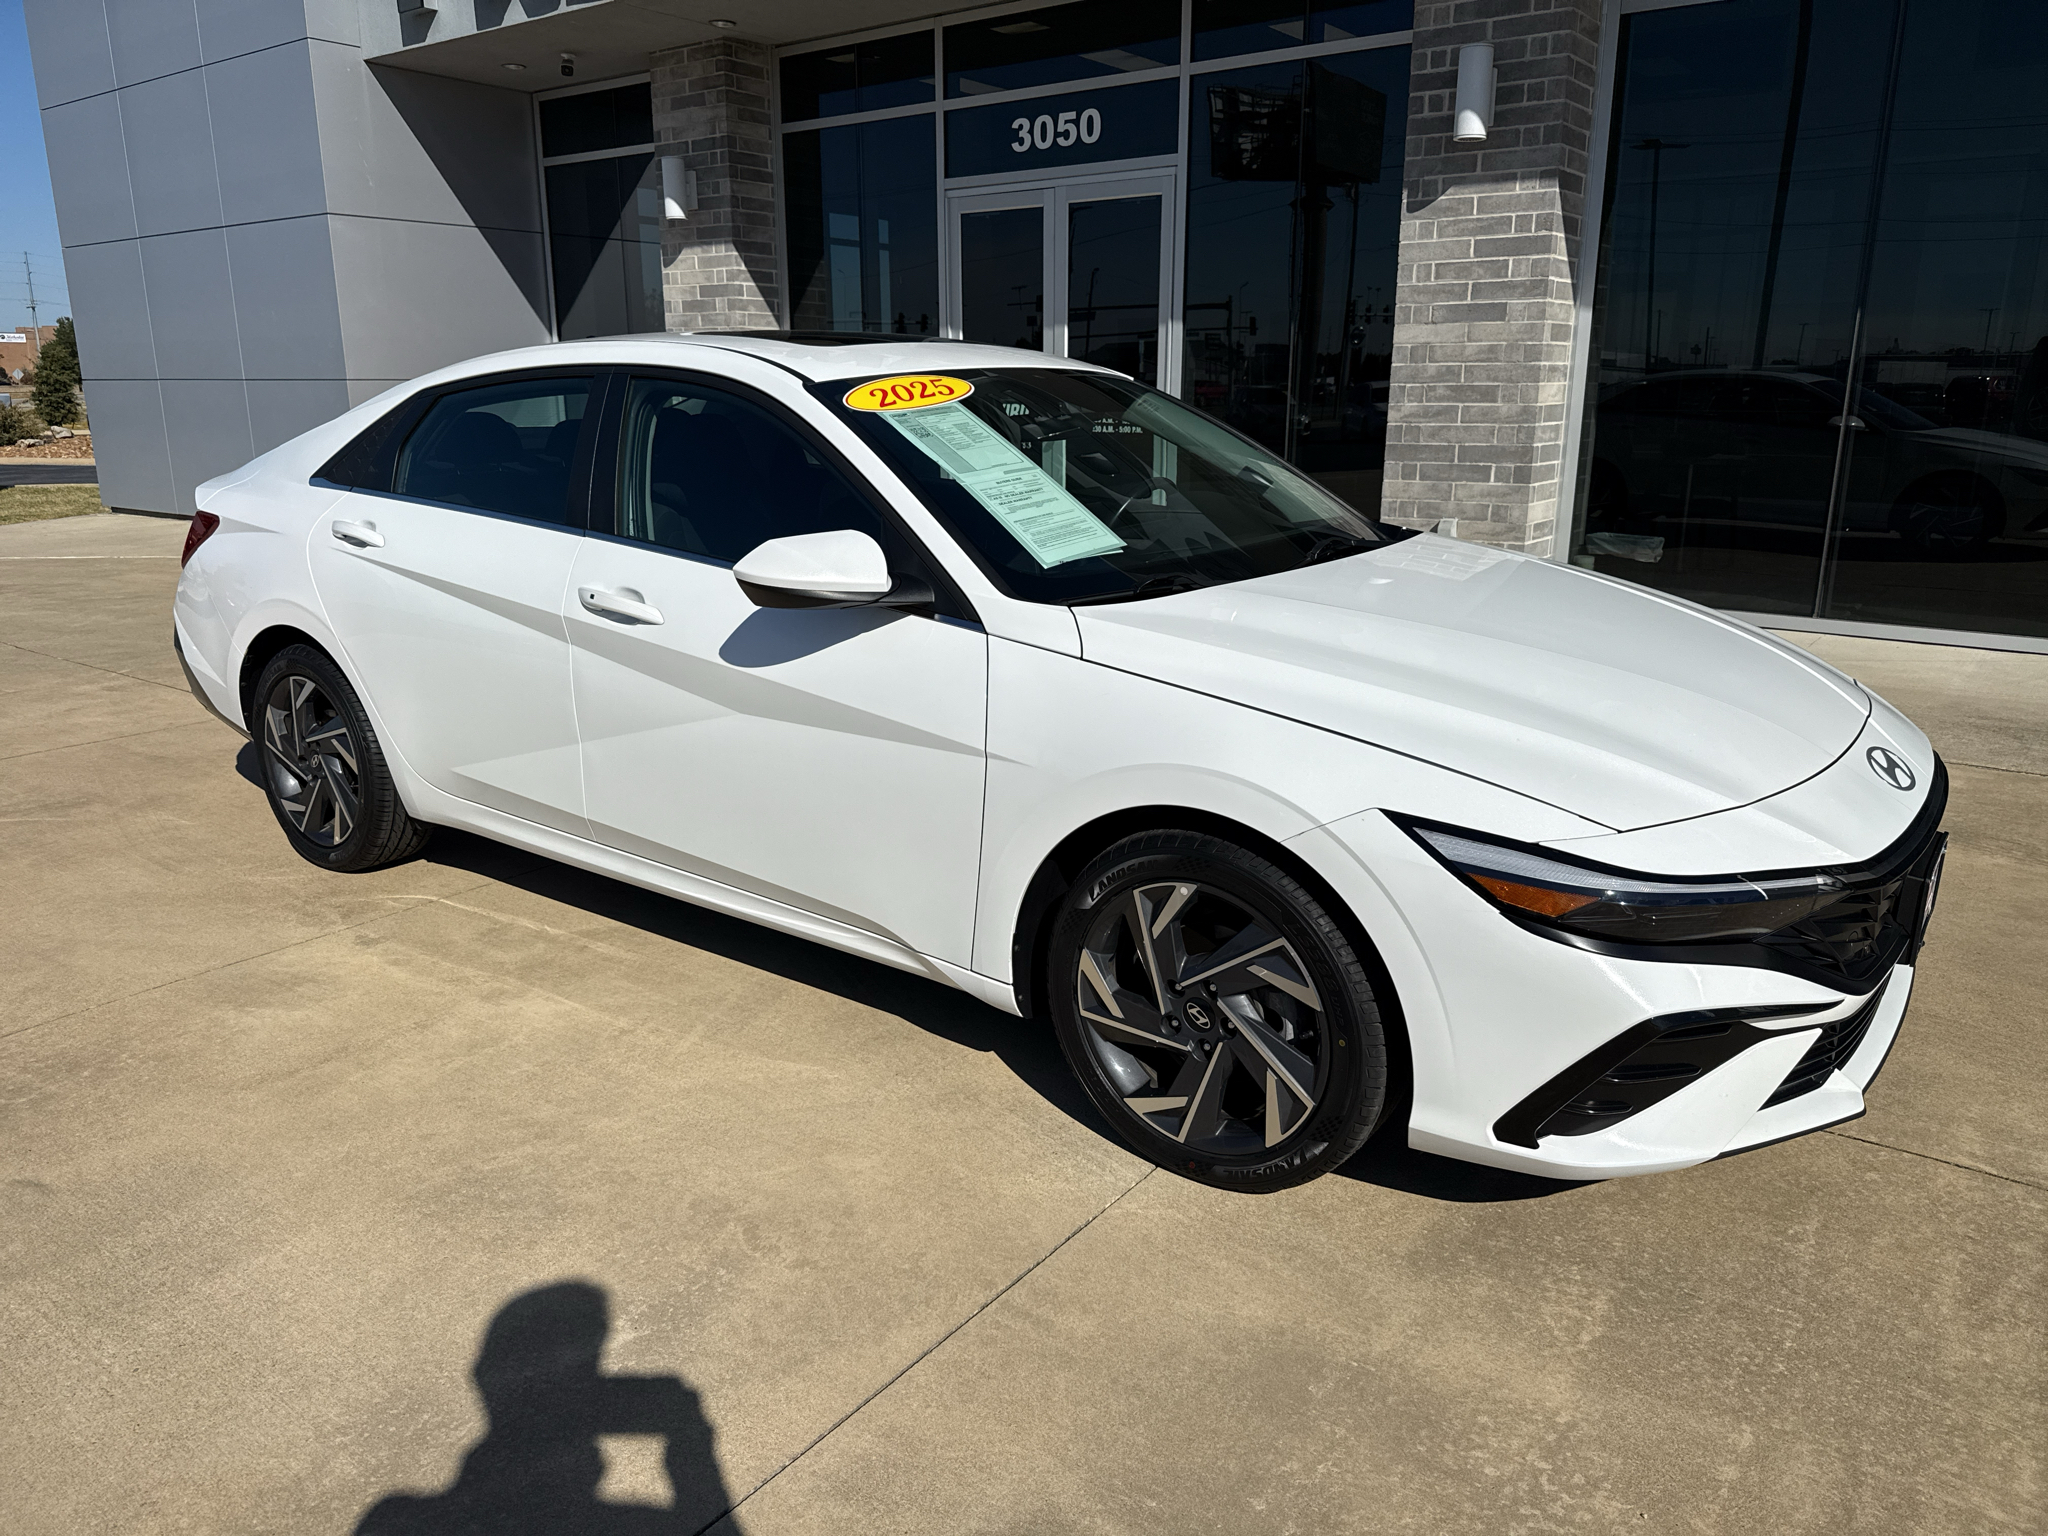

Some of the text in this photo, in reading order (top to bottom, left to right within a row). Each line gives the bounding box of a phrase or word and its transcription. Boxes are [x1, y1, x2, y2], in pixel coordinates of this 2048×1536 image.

[1011, 108, 1101, 153] 3050
[869, 379, 955, 408] 2025
[1102, 425, 1115, 433] A.M.
[1131, 426, 1144, 434] P.M.
